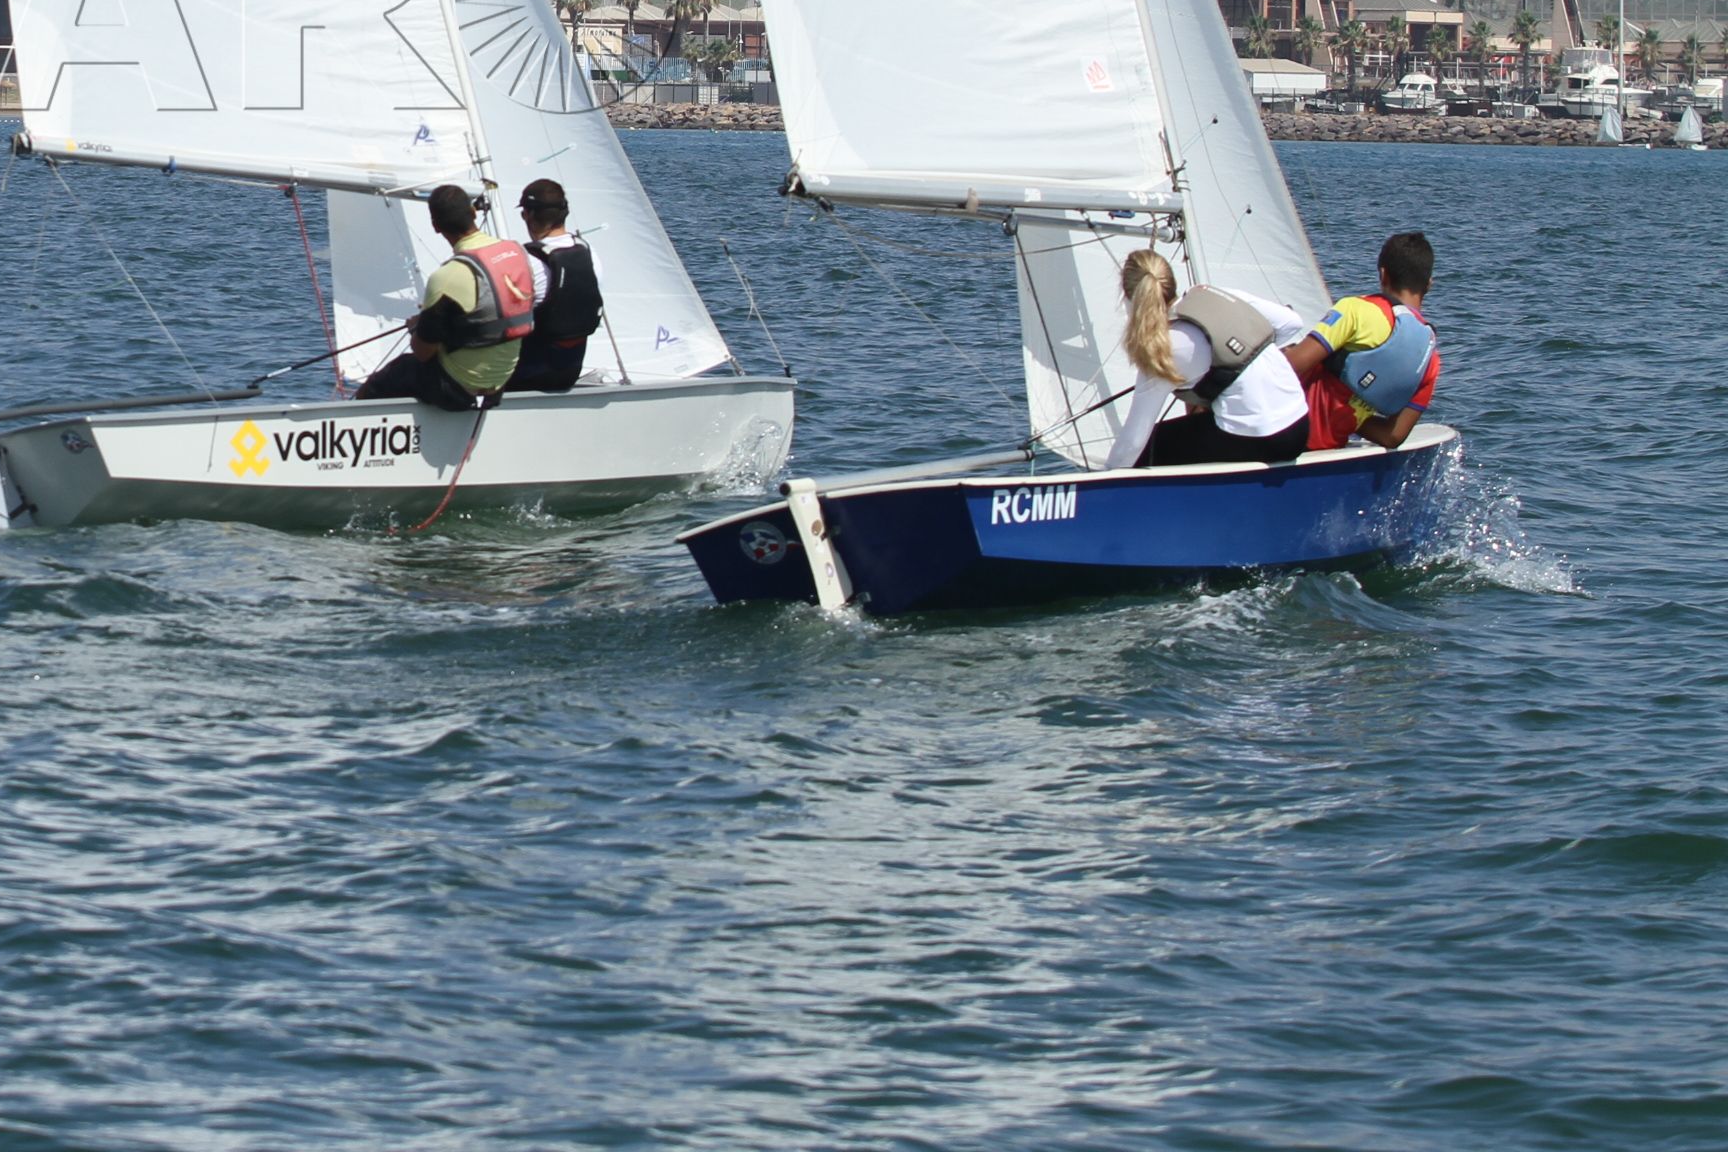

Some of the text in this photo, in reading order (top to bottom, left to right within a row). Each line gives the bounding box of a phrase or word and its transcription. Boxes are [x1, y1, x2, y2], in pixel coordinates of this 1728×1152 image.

[273, 417, 411, 468] valkyria
[317, 458, 395, 471] VIKING ATTITUDE
[990, 484, 1077, 525] RCMM
